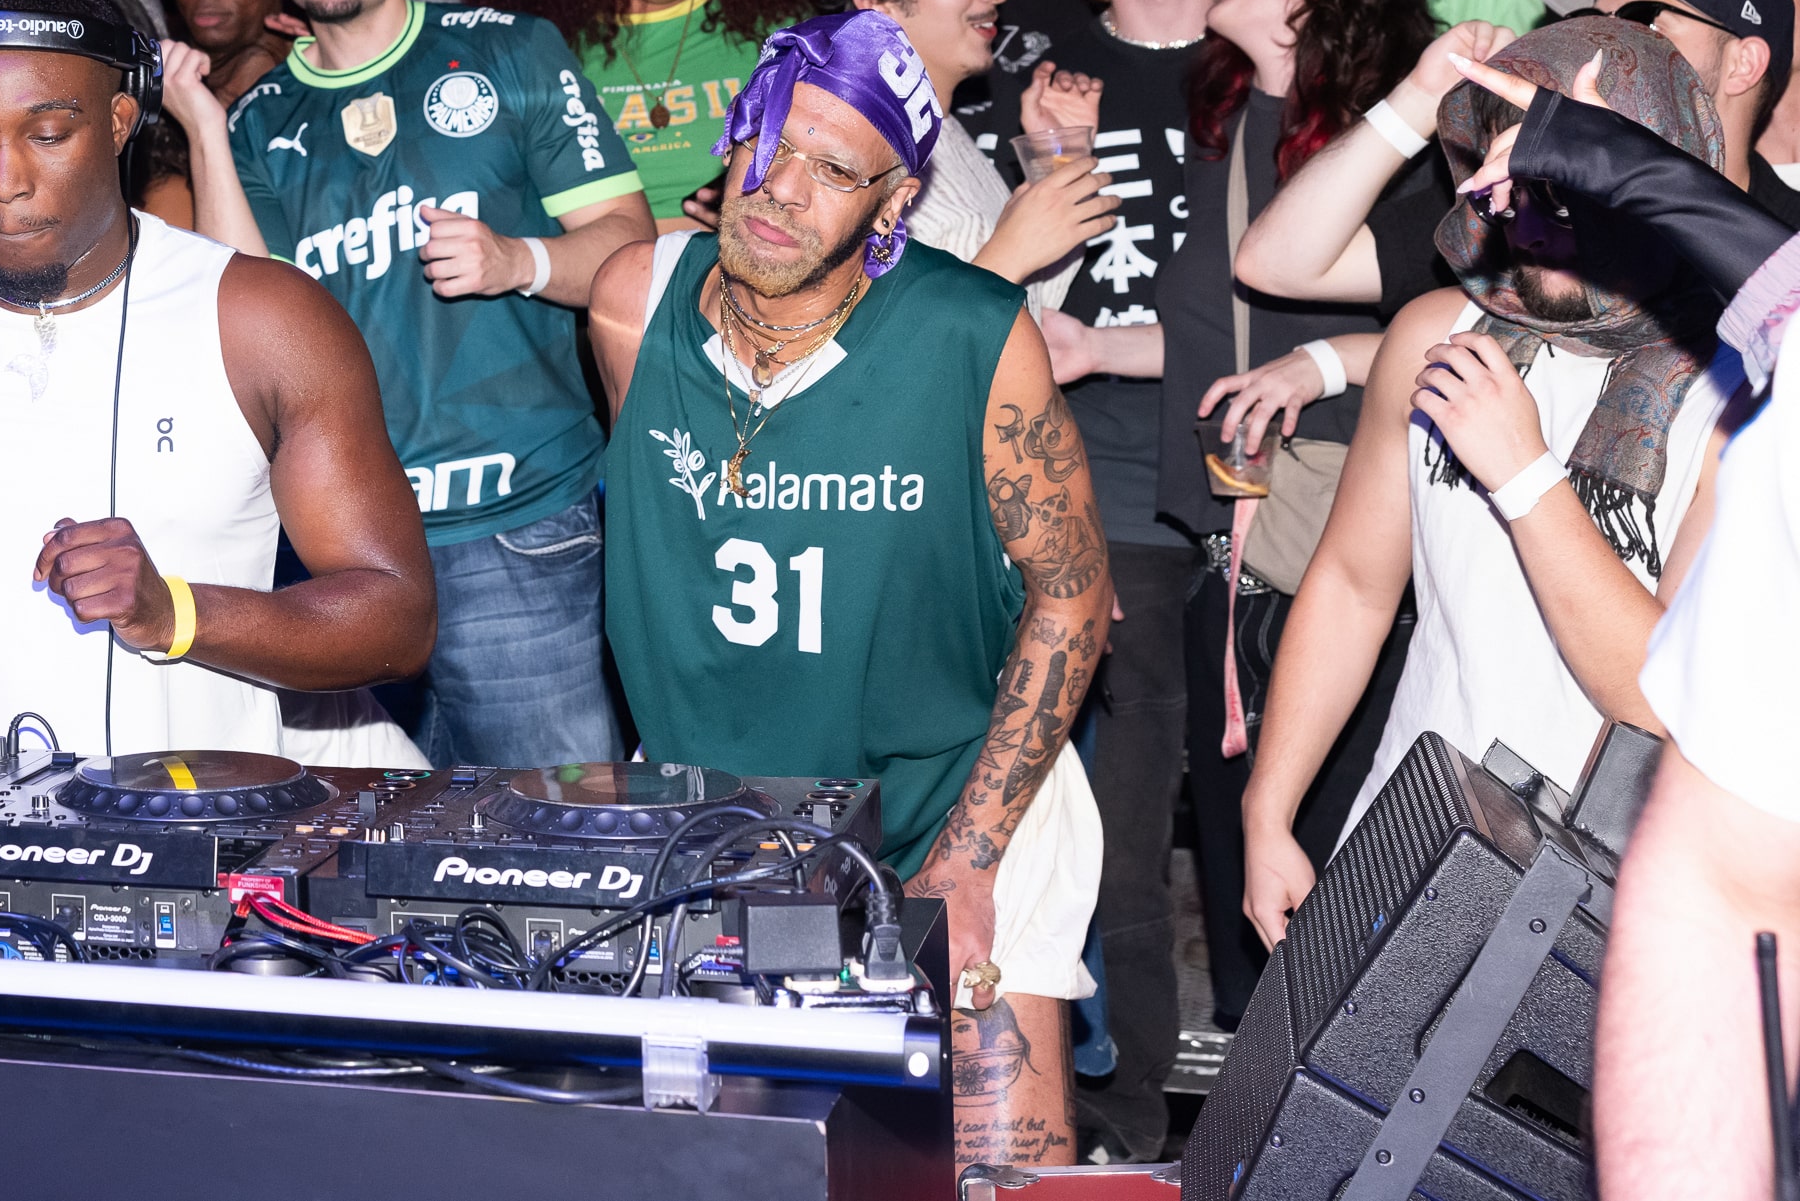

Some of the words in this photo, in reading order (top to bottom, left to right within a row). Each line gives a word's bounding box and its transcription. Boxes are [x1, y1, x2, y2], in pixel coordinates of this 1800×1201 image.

[440, 7, 516, 29] crefisa
[428, 94, 495, 133] PALMEIRAS
[558, 69, 606, 173] crefisa
[404, 451, 517, 513] am
[711, 537, 825, 655] 31
[238, 881, 275, 890] FUNKSHION
[433, 856, 592, 889] Pioneer
[90, 903, 121, 912] Pioneer
[93, 913, 128, 923] CDJ-3000
